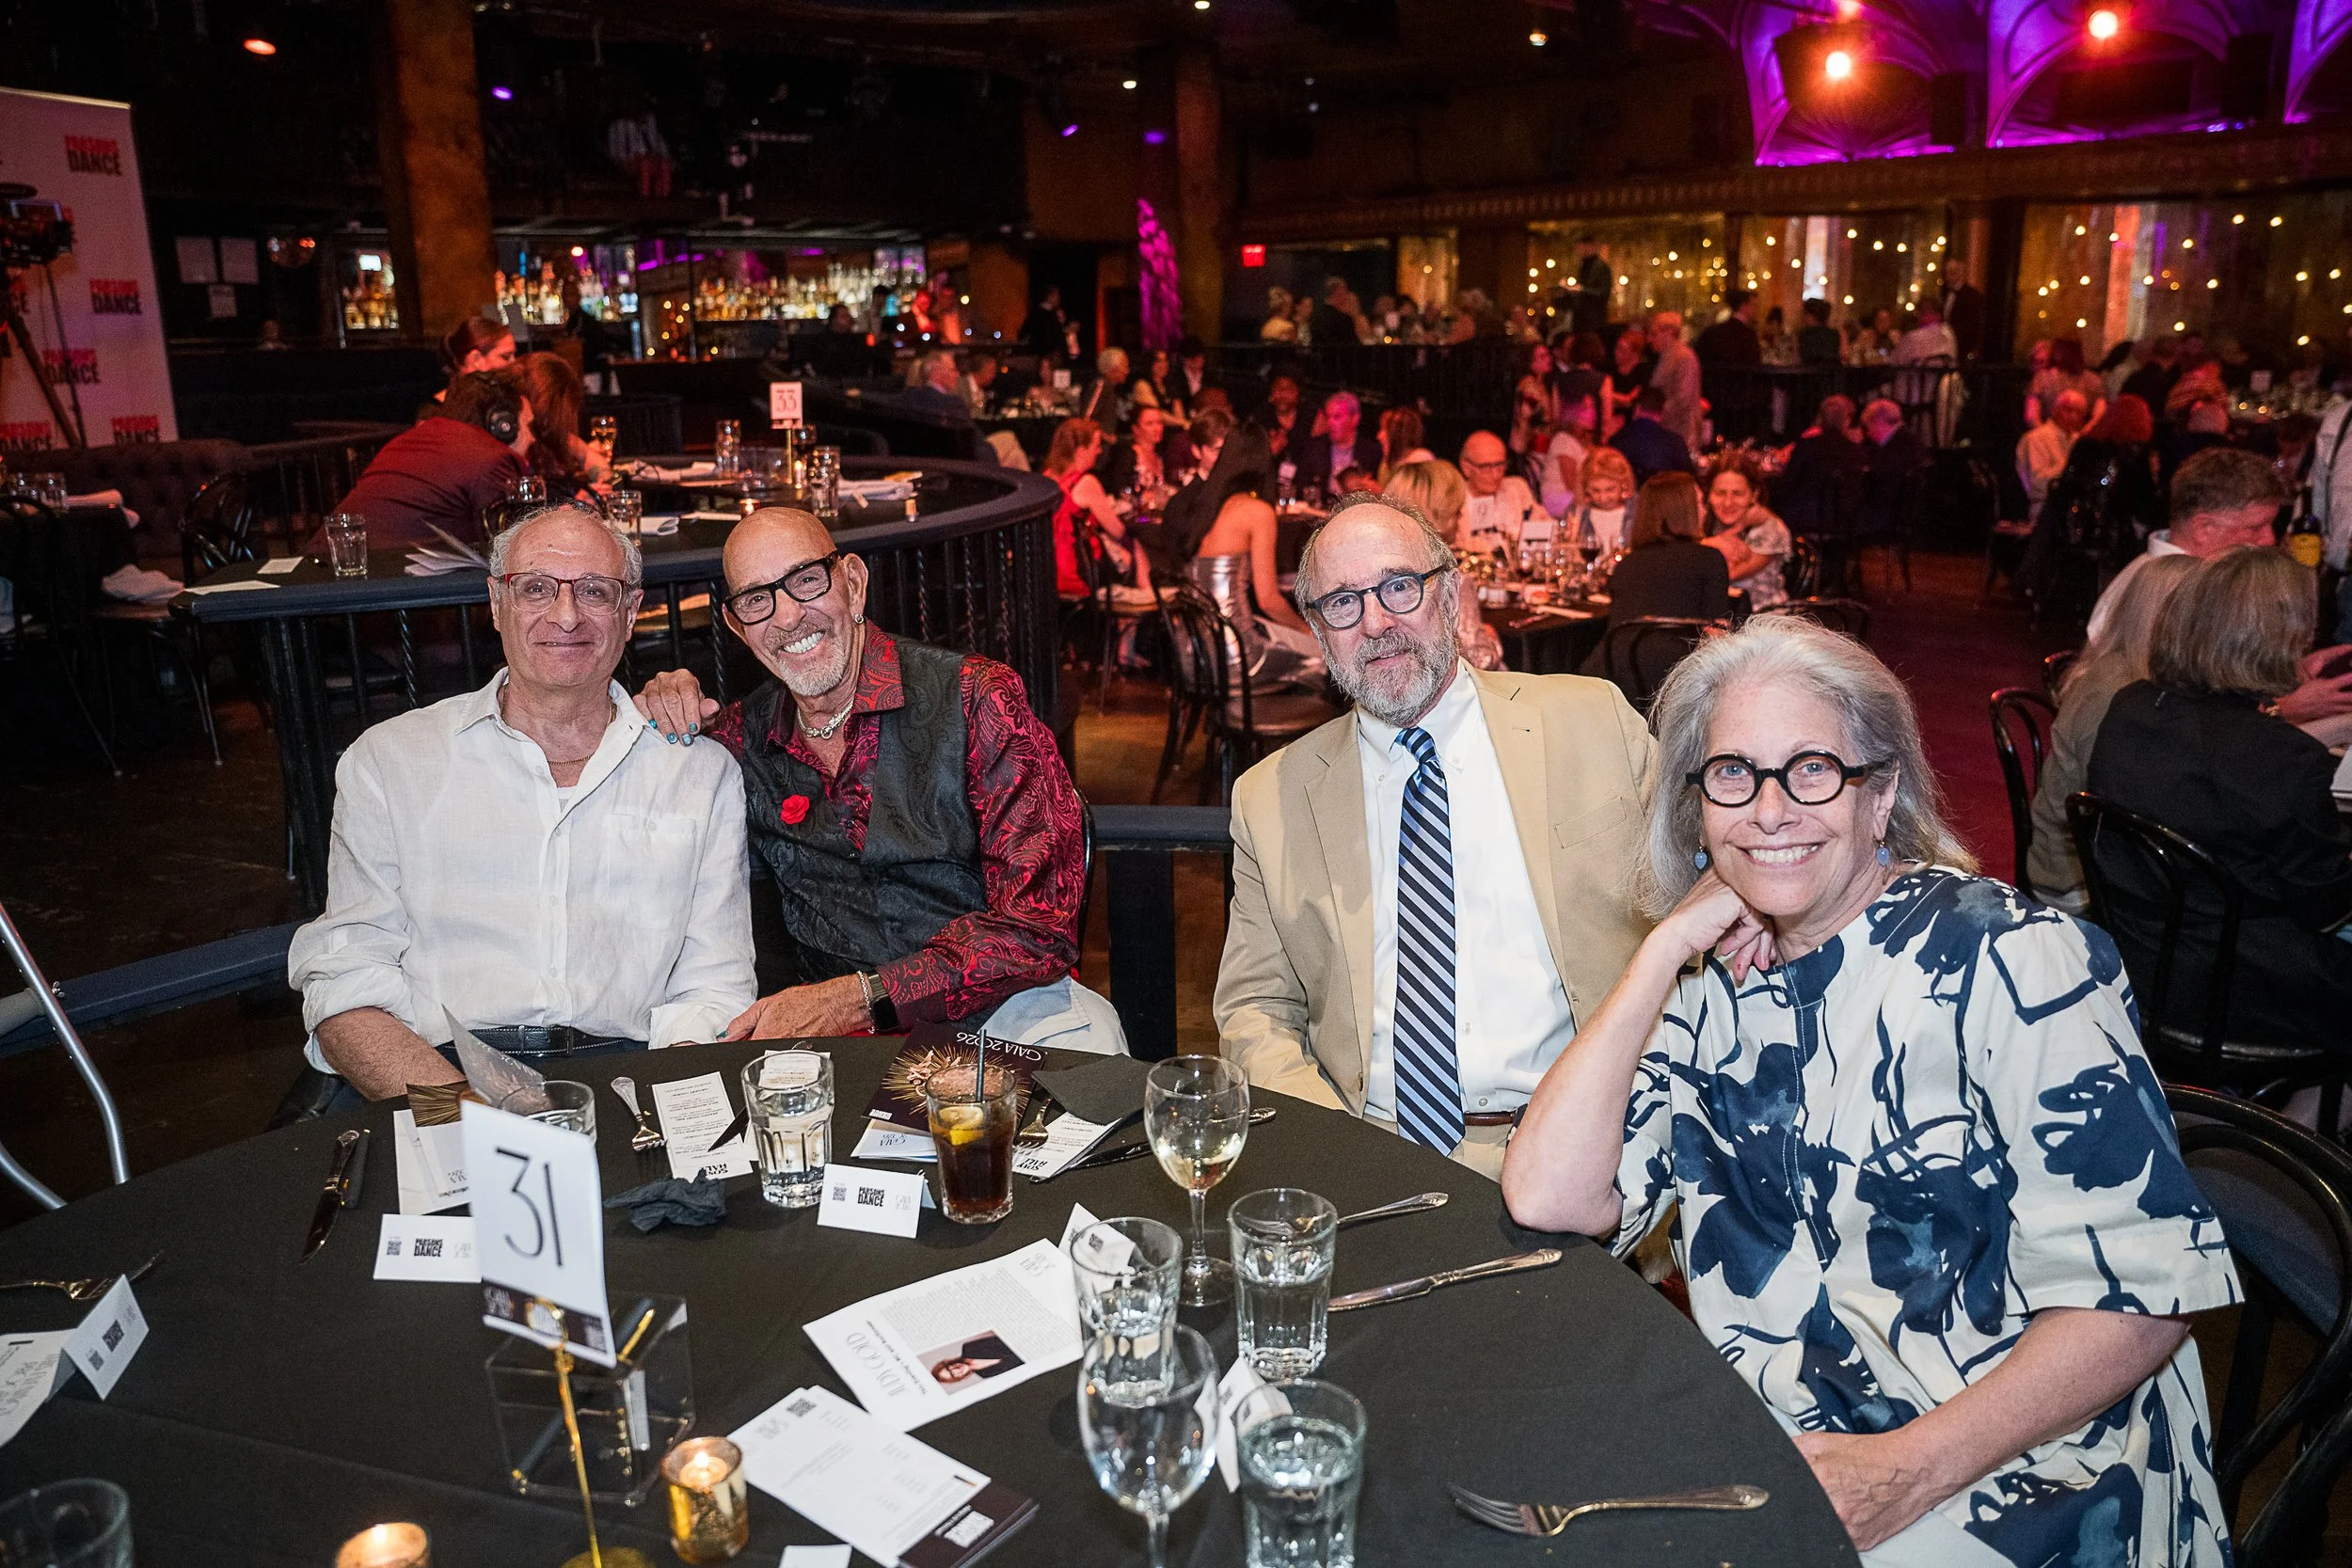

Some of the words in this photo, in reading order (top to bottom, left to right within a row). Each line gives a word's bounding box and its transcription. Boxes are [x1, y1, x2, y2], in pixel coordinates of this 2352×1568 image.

[776, 389, 797, 412] 33
[956, 1031, 1001, 1052] 2026
[1005, 1043, 1041, 1062] GALA
[493, 1146, 564, 1268] 31
[857, 1192, 884, 1207] DANCE
[414, 1244, 442, 1257] DANCE
